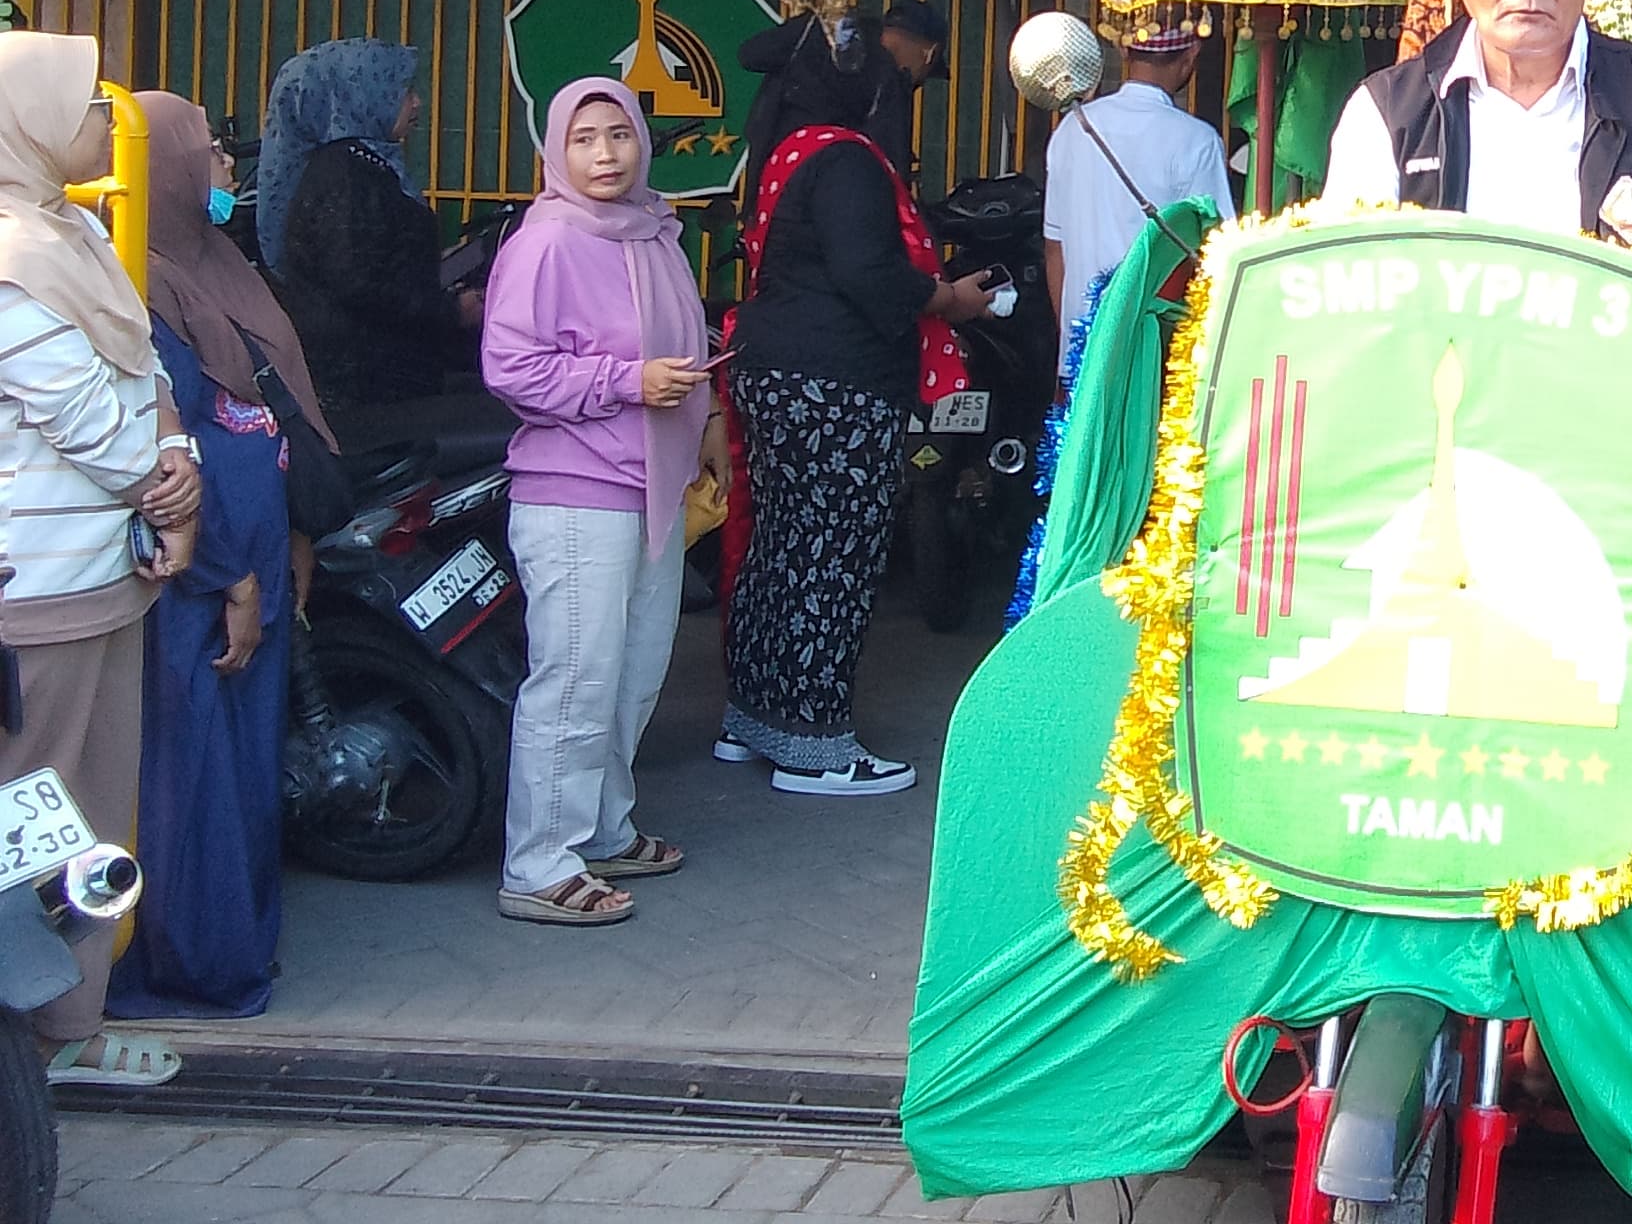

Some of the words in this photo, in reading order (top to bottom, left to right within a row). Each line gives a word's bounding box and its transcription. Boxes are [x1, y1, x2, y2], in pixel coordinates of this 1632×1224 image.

[1279, 257, 1420, 319] SMP
[1437, 259, 1579, 330] YPM
[1592, 282, 1632, 337] 3
[408, 600, 432, 625] W
[1340, 793, 1504, 845] TAMAN
